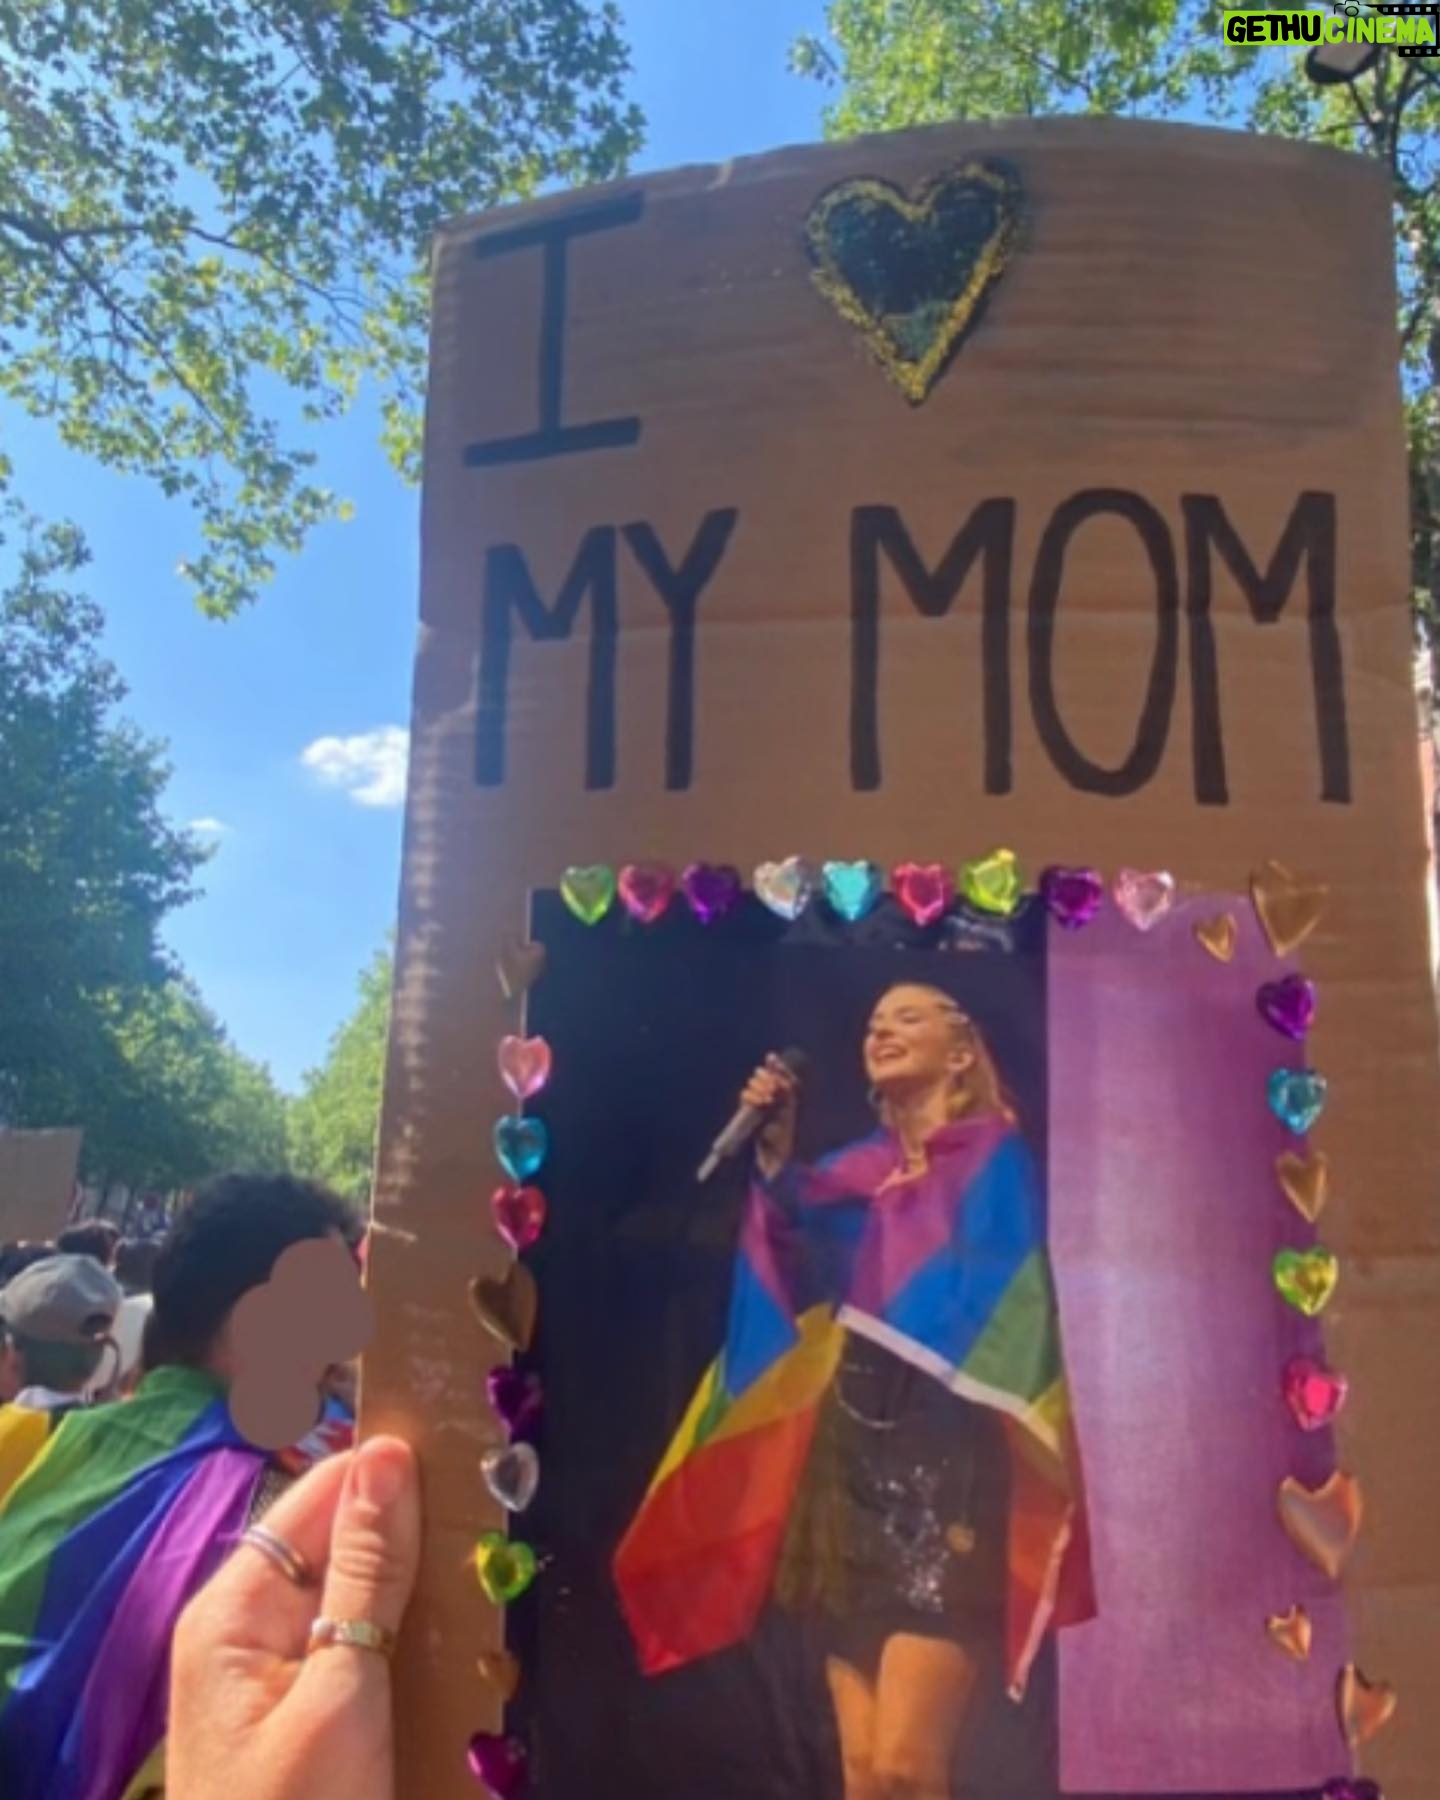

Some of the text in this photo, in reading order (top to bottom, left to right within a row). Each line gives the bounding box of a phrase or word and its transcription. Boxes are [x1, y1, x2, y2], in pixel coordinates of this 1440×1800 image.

[463, 191, 643, 467] I
[474, 487, 1352, 805] MY MOM
